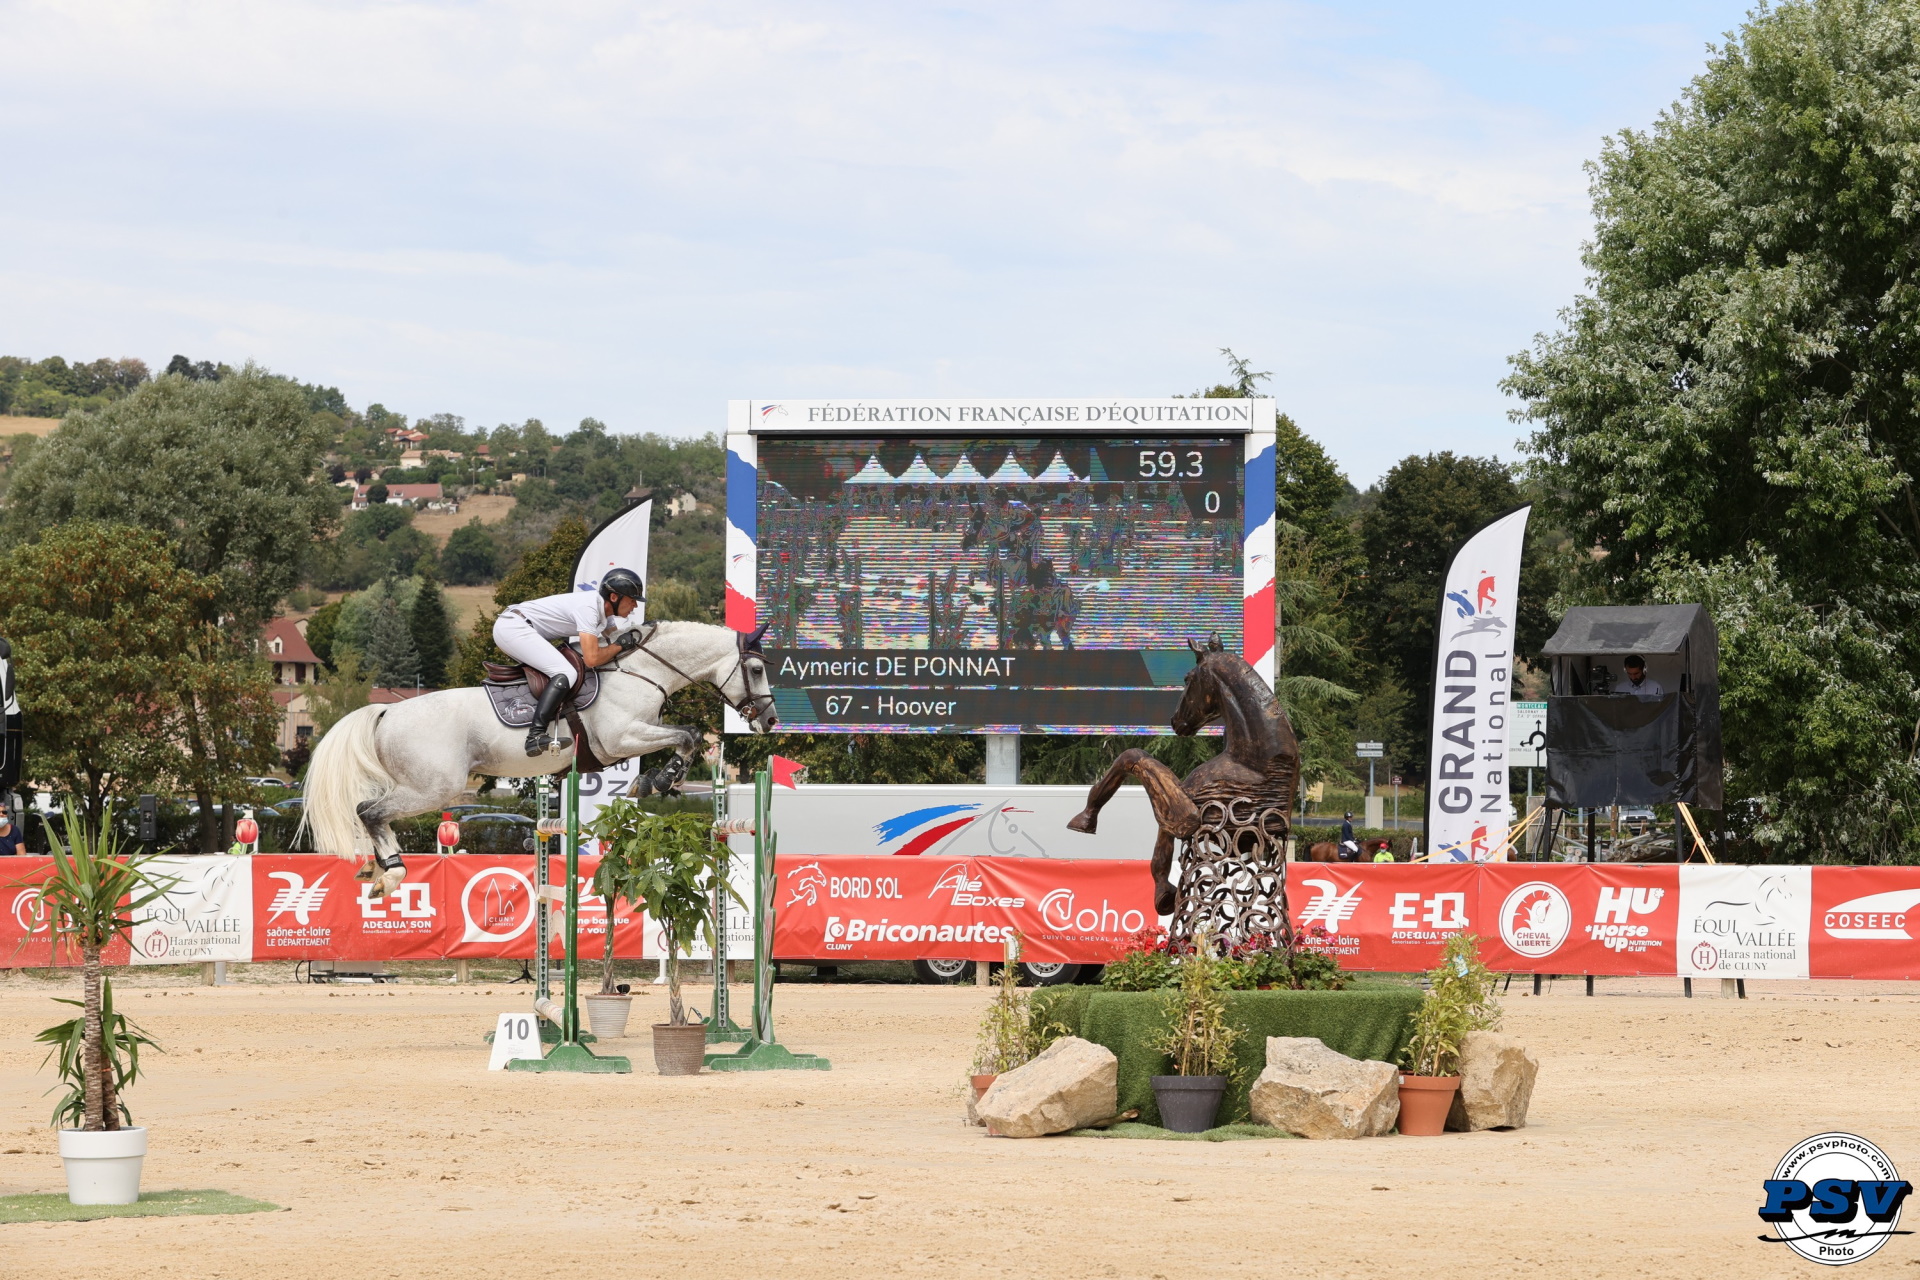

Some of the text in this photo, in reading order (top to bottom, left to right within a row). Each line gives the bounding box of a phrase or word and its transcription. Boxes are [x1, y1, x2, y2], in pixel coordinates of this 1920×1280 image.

[808, 402, 1249, 426] FÉDÉRATION FRANÇAISE D'ÉQUITATION
[1139, 450, 1203, 478] 59.3
[1204, 490, 1220, 514] 0
[779, 656, 1016, 680] Aymeric DE PONNAT
[825, 695, 853, 716] 67
[877, 695, 957, 716] Hoover
[1438, 650, 1477, 814] GRAND
[1480, 650, 1507, 813] National
[830, 876, 903, 899] BORD SOL
[951, 893, 1026, 908] Boxes
[1037, 888, 1145, 933] Coho
[146, 905, 187, 925] ÉQUI
[184, 915, 241, 933] VALLÉE
[410, 920, 432, 929] SON
[1824, 913, 1906, 928] COSEEC
[266, 926, 331, 937] saône-et-loire
[845, 918, 1014, 943] Briconautes
[1516, 932, 1551, 940] CHEVAL
[1694, 915, 1737, 937] ÉQUI
[169, 935, 241, 946] Haras national
[266, 936, 331, 947] LE DÉPARTEMENT
[1736, 928, 1796, 947] VALLÉE
[168, 946, 213, 956] de CLUNY
[1719, 949, 1797, 960] Haras national
[1718, 960, 1768, 971] de CLUNY
[504, 1018, 530, 1040] 10
